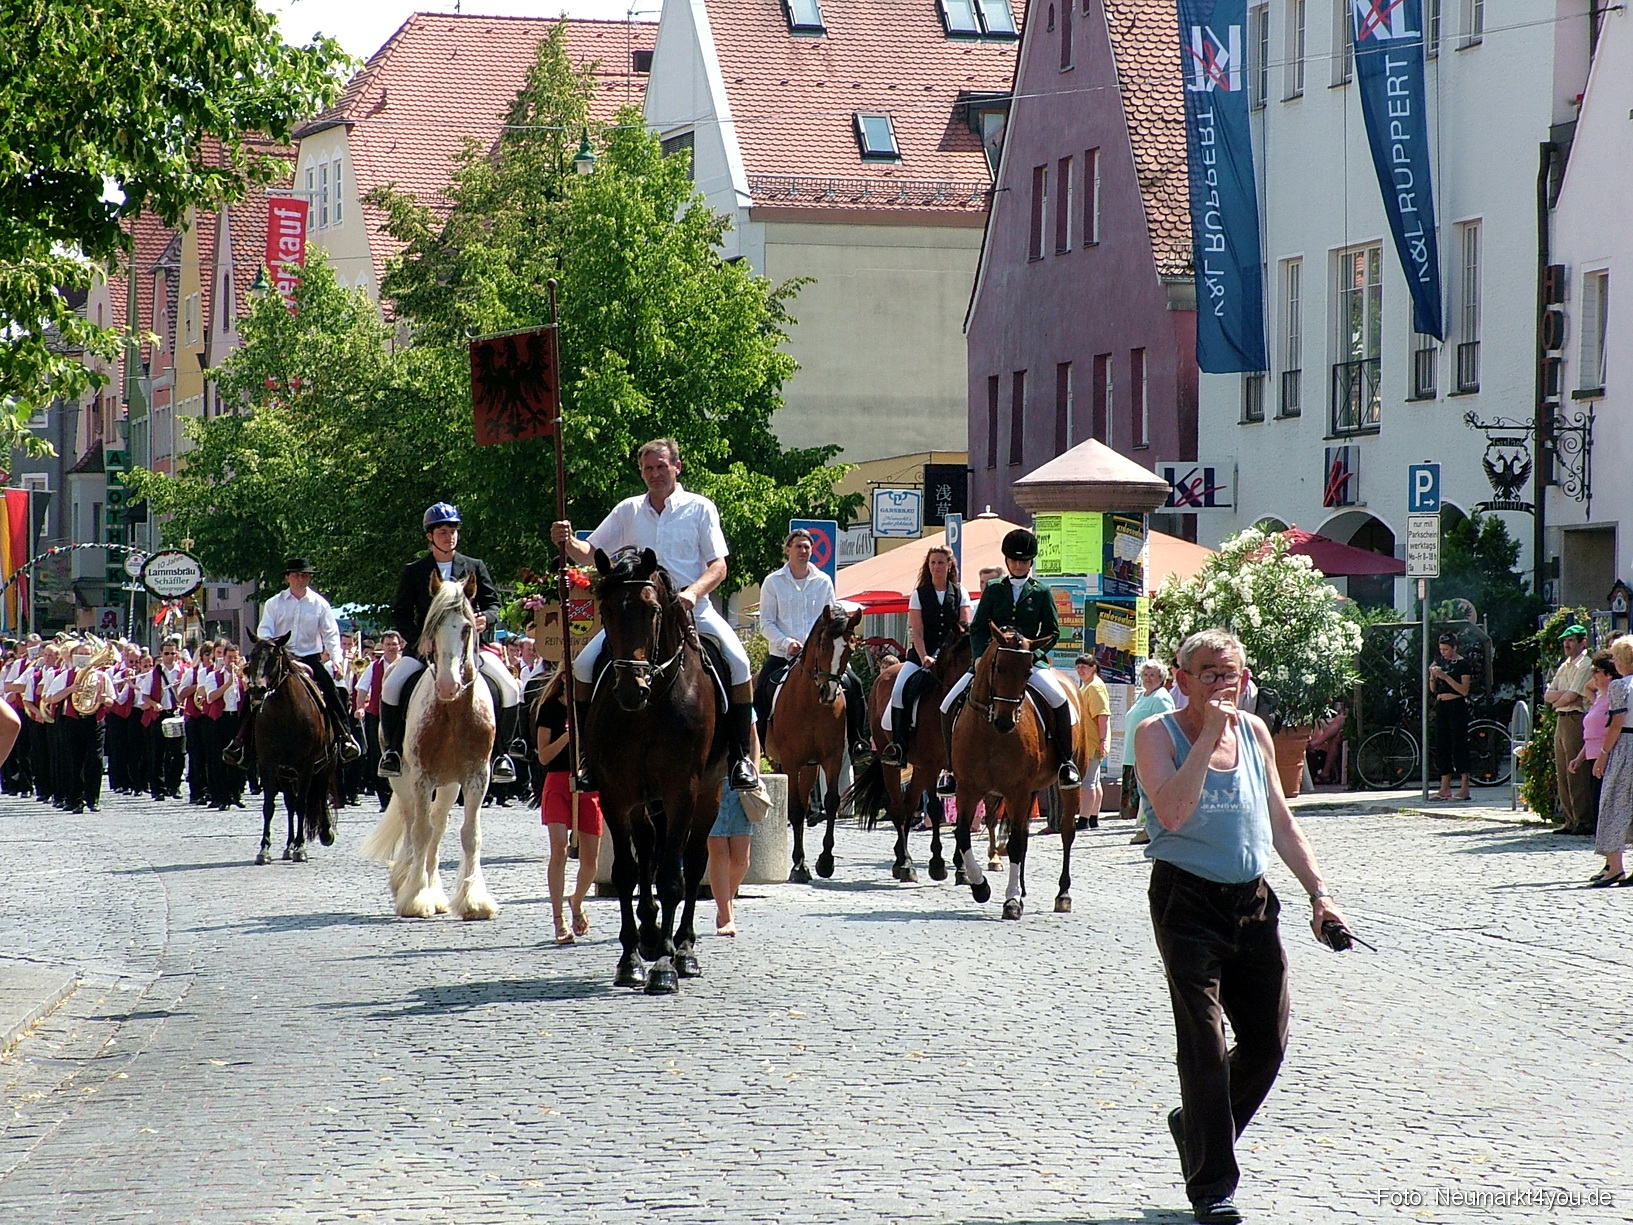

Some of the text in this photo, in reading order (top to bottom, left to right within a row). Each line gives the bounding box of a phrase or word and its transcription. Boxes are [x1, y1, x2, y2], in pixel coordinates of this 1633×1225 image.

[1385, 55, 1417, 213] RUPPERT
[1164, 467, 1232, 507] K&L
[1415, 469, 1433, 507] P
[108, 451, 122, 602] APOTHEKE
[948, 521, 959, 546] P
[1410, 542, 1436, 552] werktags
[148, 567, 196, 577] Lammsbräu
[154, 577, 190, 586] Schäffler
